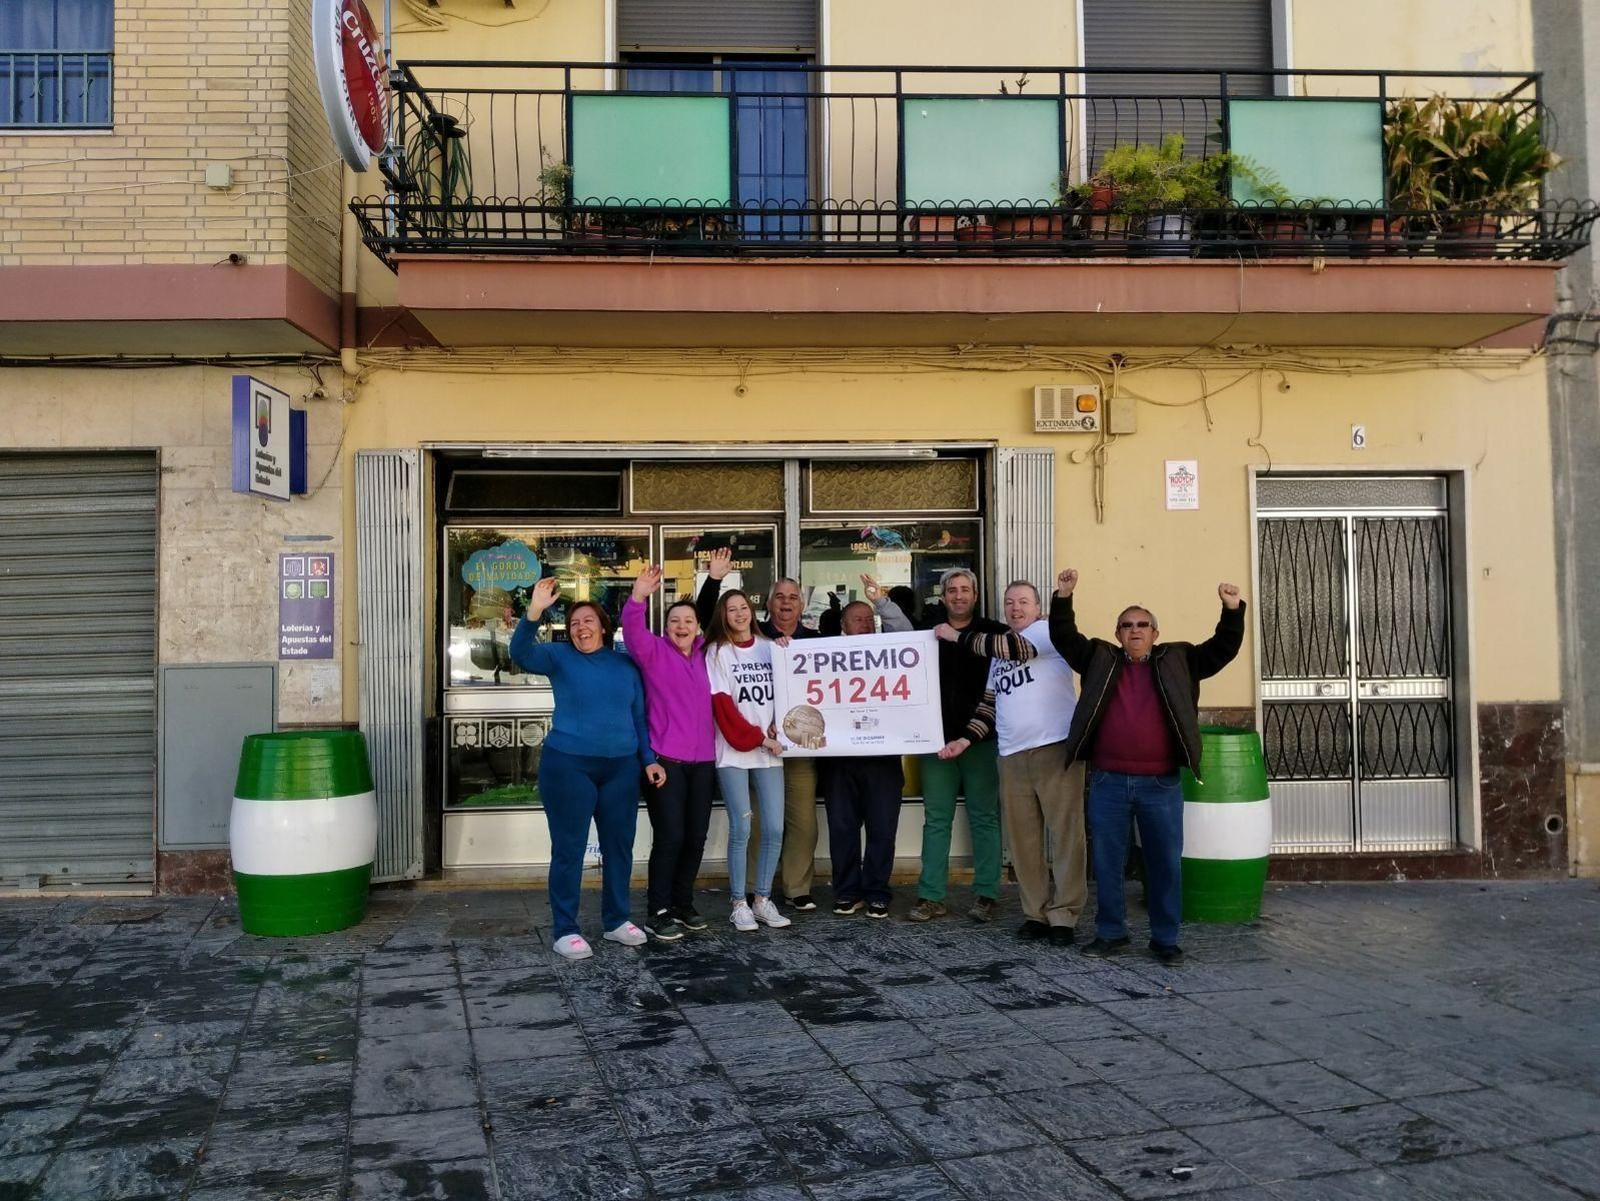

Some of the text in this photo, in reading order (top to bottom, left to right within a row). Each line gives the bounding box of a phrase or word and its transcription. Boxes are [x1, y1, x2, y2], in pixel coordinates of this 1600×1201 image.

[343, 10, 389, 143] Cruzcampo
[367, 91, 377, 125] 1904
[1036, 419, 1081, 428] EXTINMAN
[1353, 427, 1364, 446] 6
[255, 461, 275, 475] Apuestas
[255, 473, 271, 486] Estado
[850, 542, 872, 551] LOCAL
[694, 551, 712, 559] LOCA
[476, 561, 527, 571] EL GORDO
[468, 572, 481, 582] DE
[315, 625, 320, 634] y
[281, 634, 332, 645] Apuestas del
[281, 647, 309, 655] Estado
[741, 662, 773, 671] PREMI
[738, 684, 774, 706] AQU
[806, 674, 911, 706] 51244
